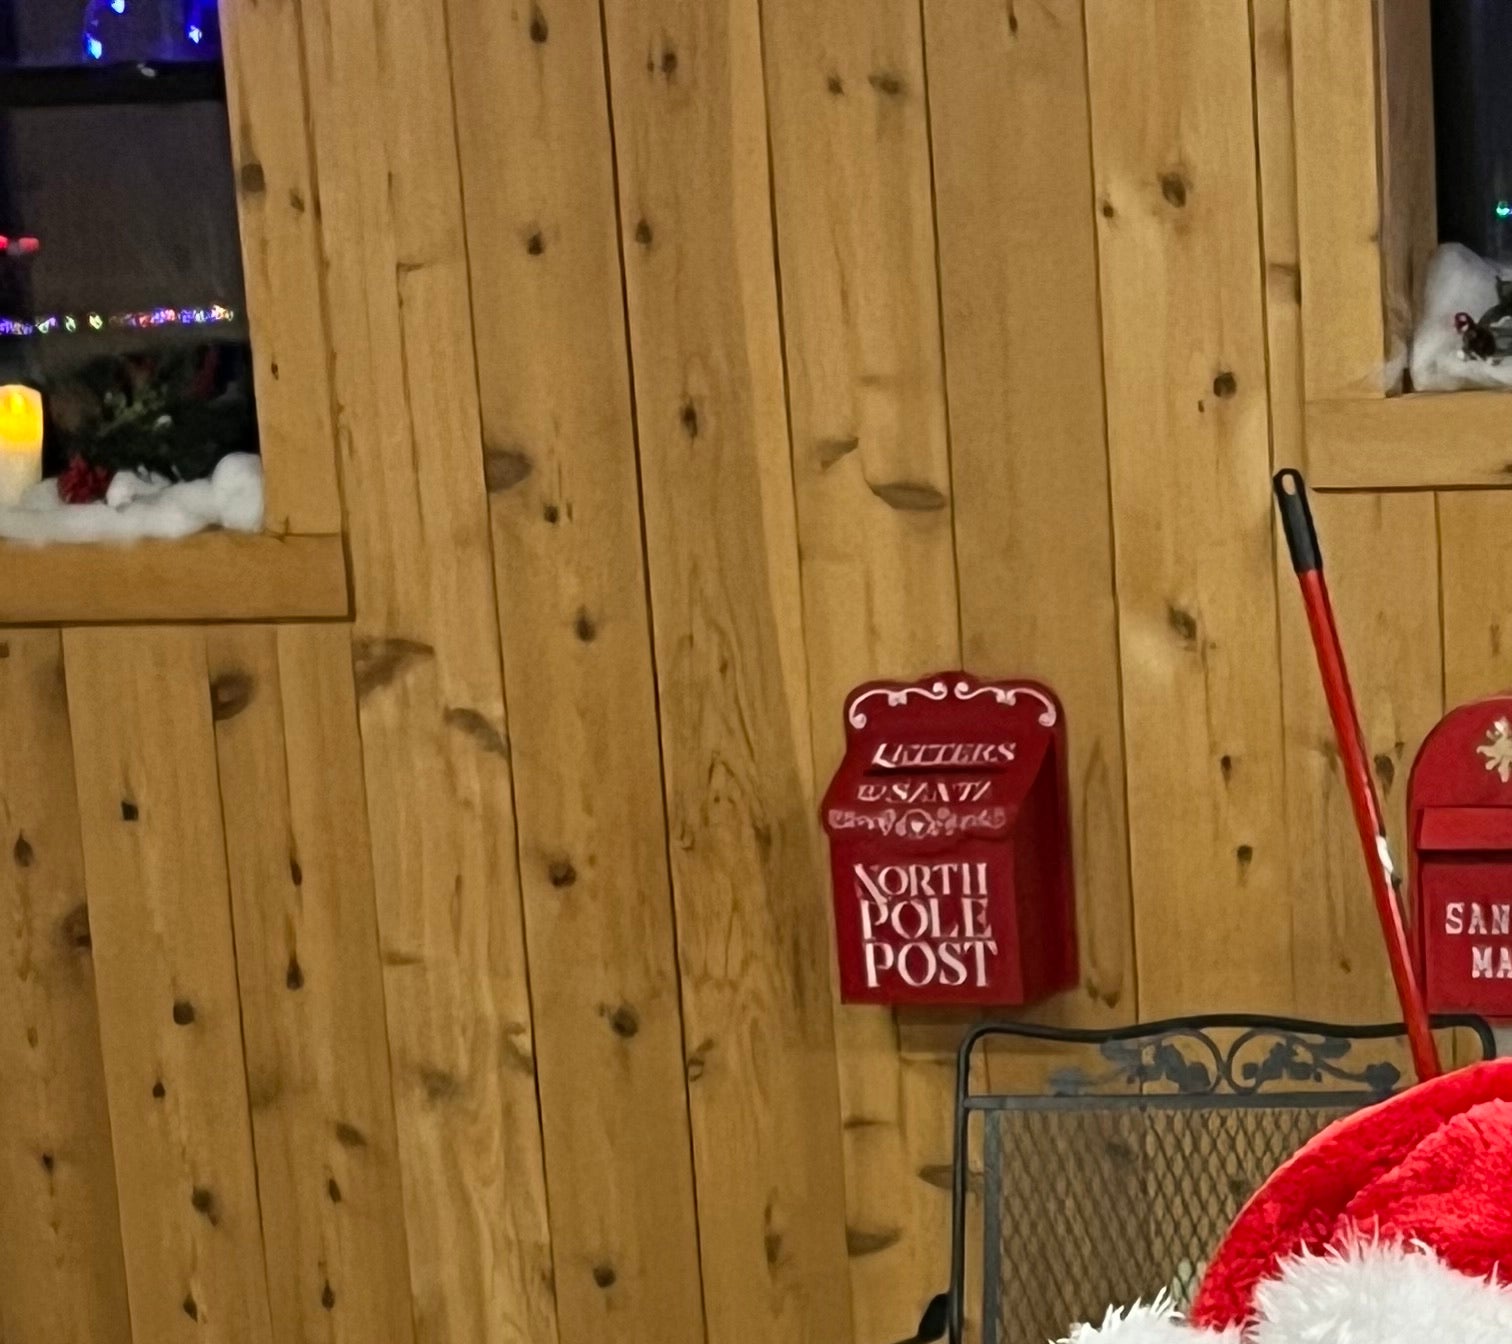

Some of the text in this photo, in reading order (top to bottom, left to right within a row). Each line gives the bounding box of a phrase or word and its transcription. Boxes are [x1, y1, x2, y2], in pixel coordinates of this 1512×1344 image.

[872, 742, 1017, 768] LETTERS
[854, 862, 989, 903] NORTH
[860, 898, 992, 940] POLE
[864, 939, 998, 988] POST
